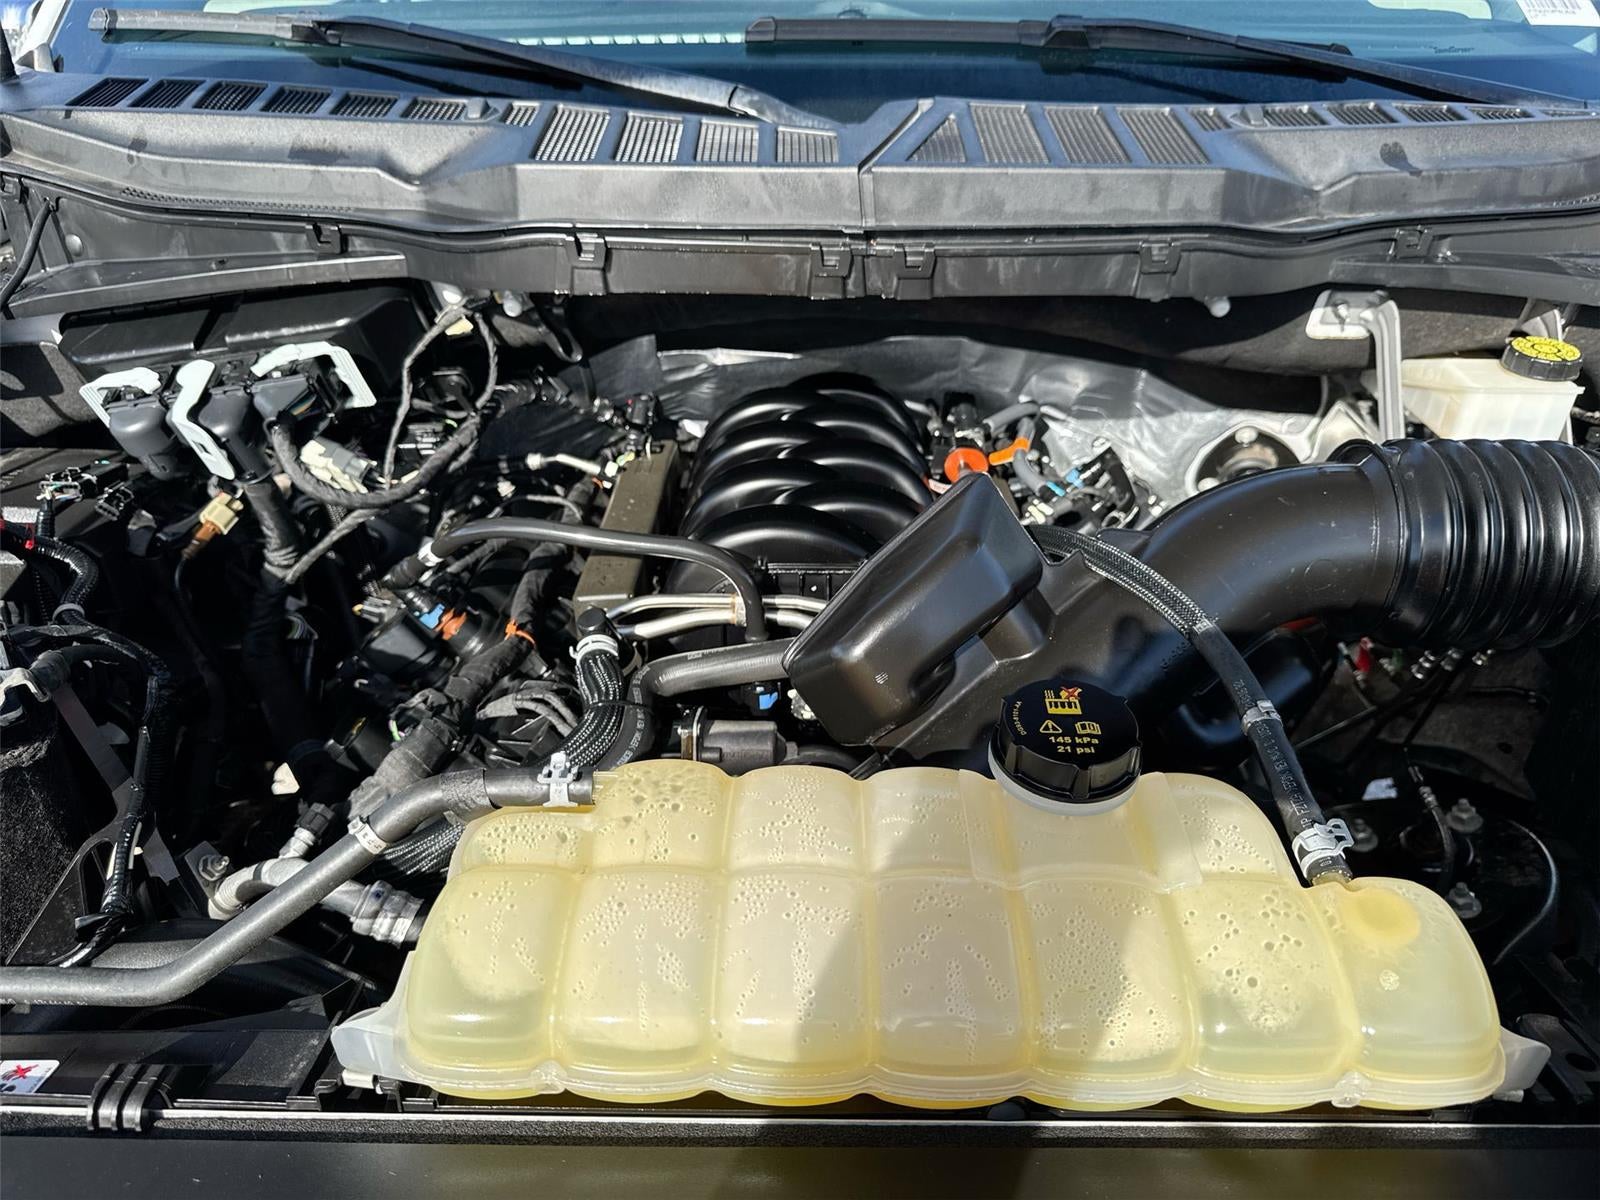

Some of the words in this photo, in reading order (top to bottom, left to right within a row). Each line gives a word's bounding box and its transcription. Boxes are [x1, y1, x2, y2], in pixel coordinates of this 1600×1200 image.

[1049, 736, 1072, 744] 145
[1074, 736, 1099, 744] kPa
[1056, 745, 1072, 753] 21
[1076, 746, 1096, 754] psi
